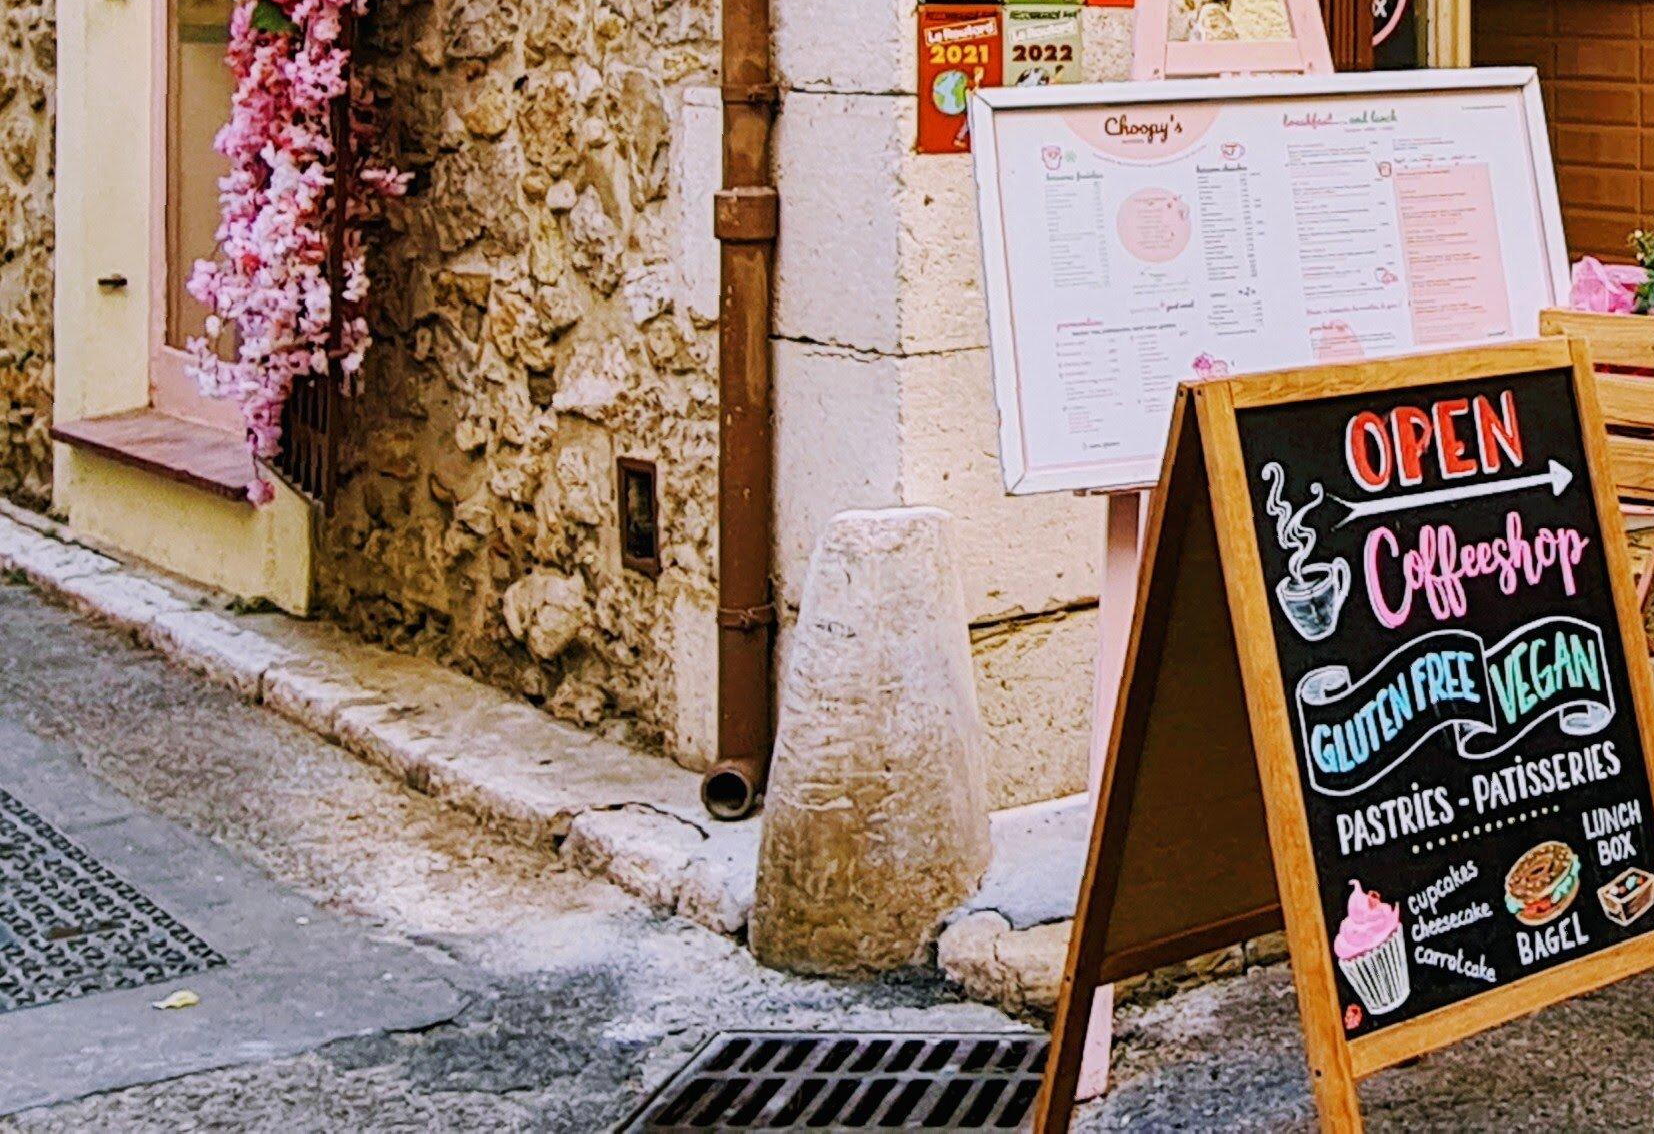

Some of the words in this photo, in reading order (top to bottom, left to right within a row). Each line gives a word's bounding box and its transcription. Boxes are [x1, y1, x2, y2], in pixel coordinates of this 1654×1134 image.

[930, 44, 989, 64] 2021
[1012, 44, 1073, 62] 2022
[1104, 114, 1183, 144] Choopy's
[1345, 389, 1523, 493] OPEN
[1364, 511, 1590, 629] Coffeeshop
[1489, 630, 1601, 724] VEGAN
[1311, 672, 1414, 774] GLUTEN
[1411, 650, 1481, 712] FREE
[1581, 799, 1643, 841] LUNCH
[1597, 831, 1638, 867] BOX
[1407, 859, 1479, 915] cupcakes
[1410, 899, 1494, 942] cheesecake
[1515, 911, 1591, 966] BAGEL
